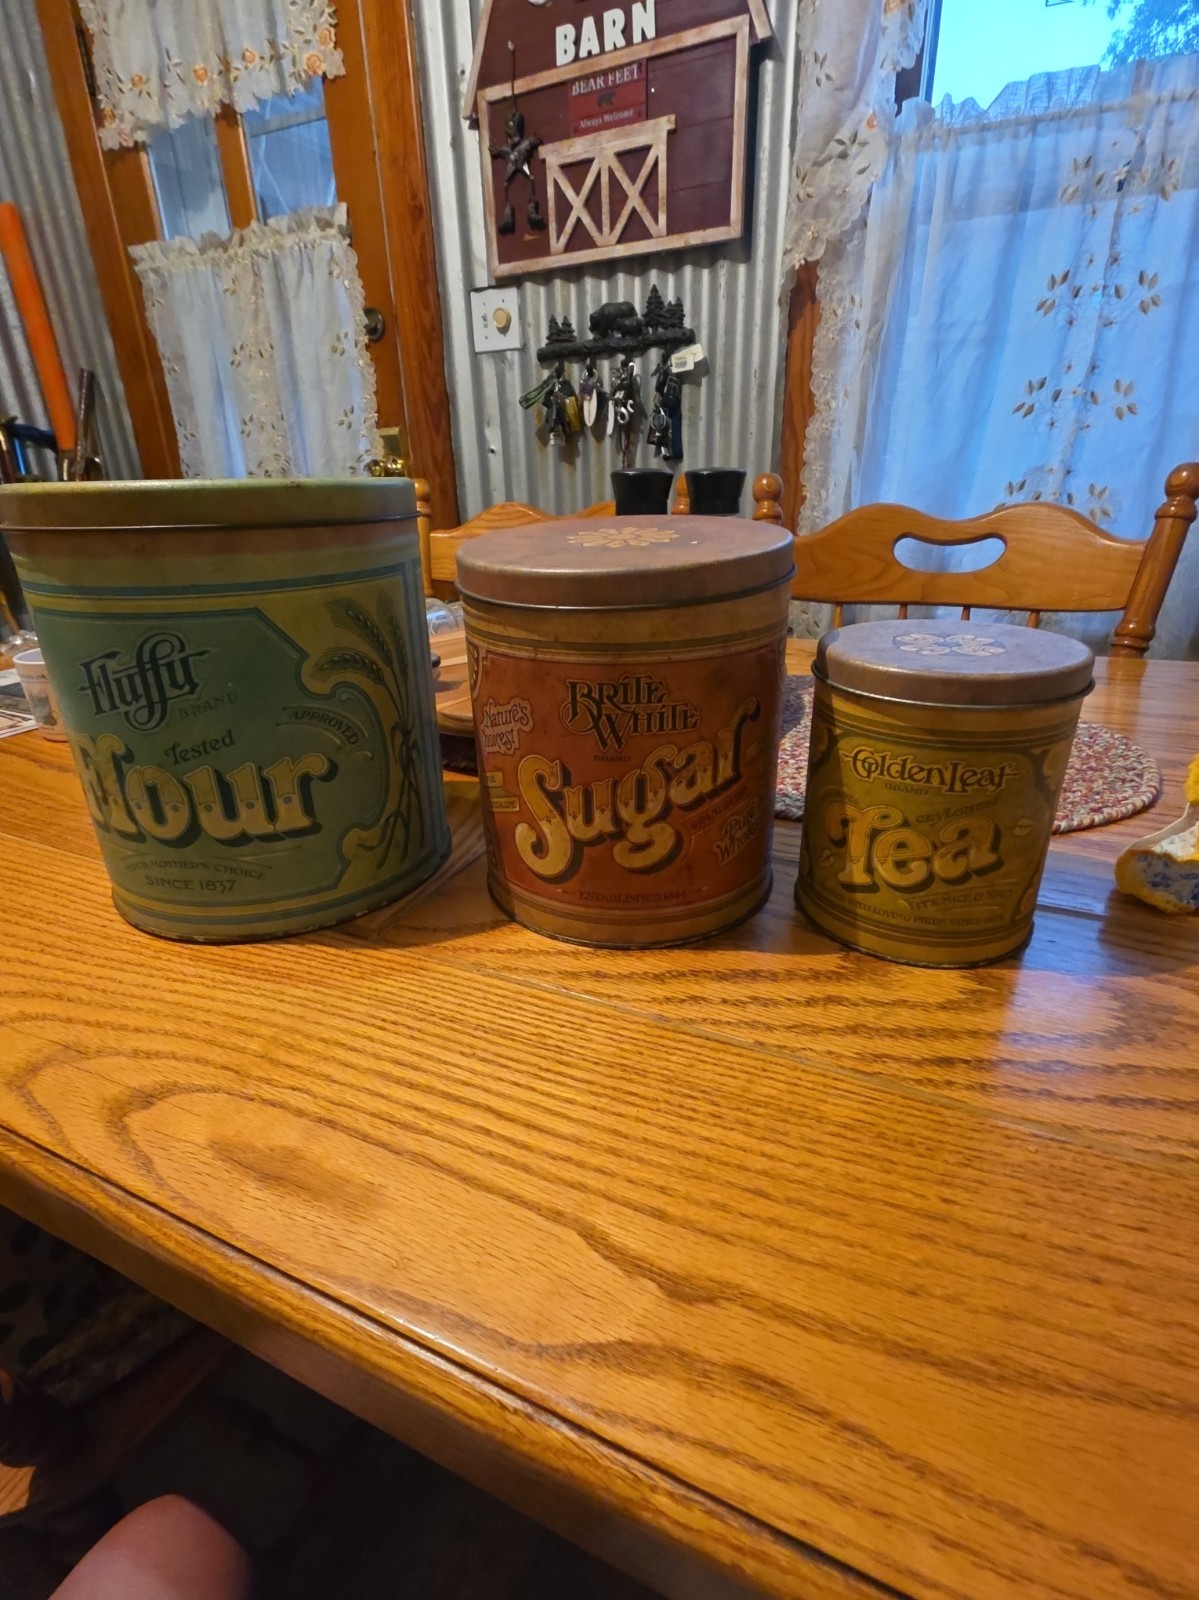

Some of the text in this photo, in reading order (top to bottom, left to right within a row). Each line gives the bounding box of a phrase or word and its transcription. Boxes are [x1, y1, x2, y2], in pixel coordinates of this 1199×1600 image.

[555, 0, 656, 67] BARN
[572, 63, 638, 96] BEAR FEET
[579, 108, 634, 129] Always Welcome
[77, 632, 211, 732] Fluffy
[178, 691, 240, 720] BRAND
[484, 701, 530, 728] Nature's
[562, 675, 668, 724] BRITE
[288, 709, 361, 746] APPROVED
[596, 703, 700, 751] WHITE
[164, 729, 236, 765] Tested
[593, 754, 632, 763] BRAND
[840, 748, 1021, 794] Golden Leaf
[514, 697, 760, 883] Sugar
[884, 782, 929, 796] BRAND
[826, 803, 1003, 893] Tea
[144, 874, 237, 895] SINCE 1837
[213, 863, 267, 882] CHOICE
[578, 890, 661, 905] ESTABLISHED
